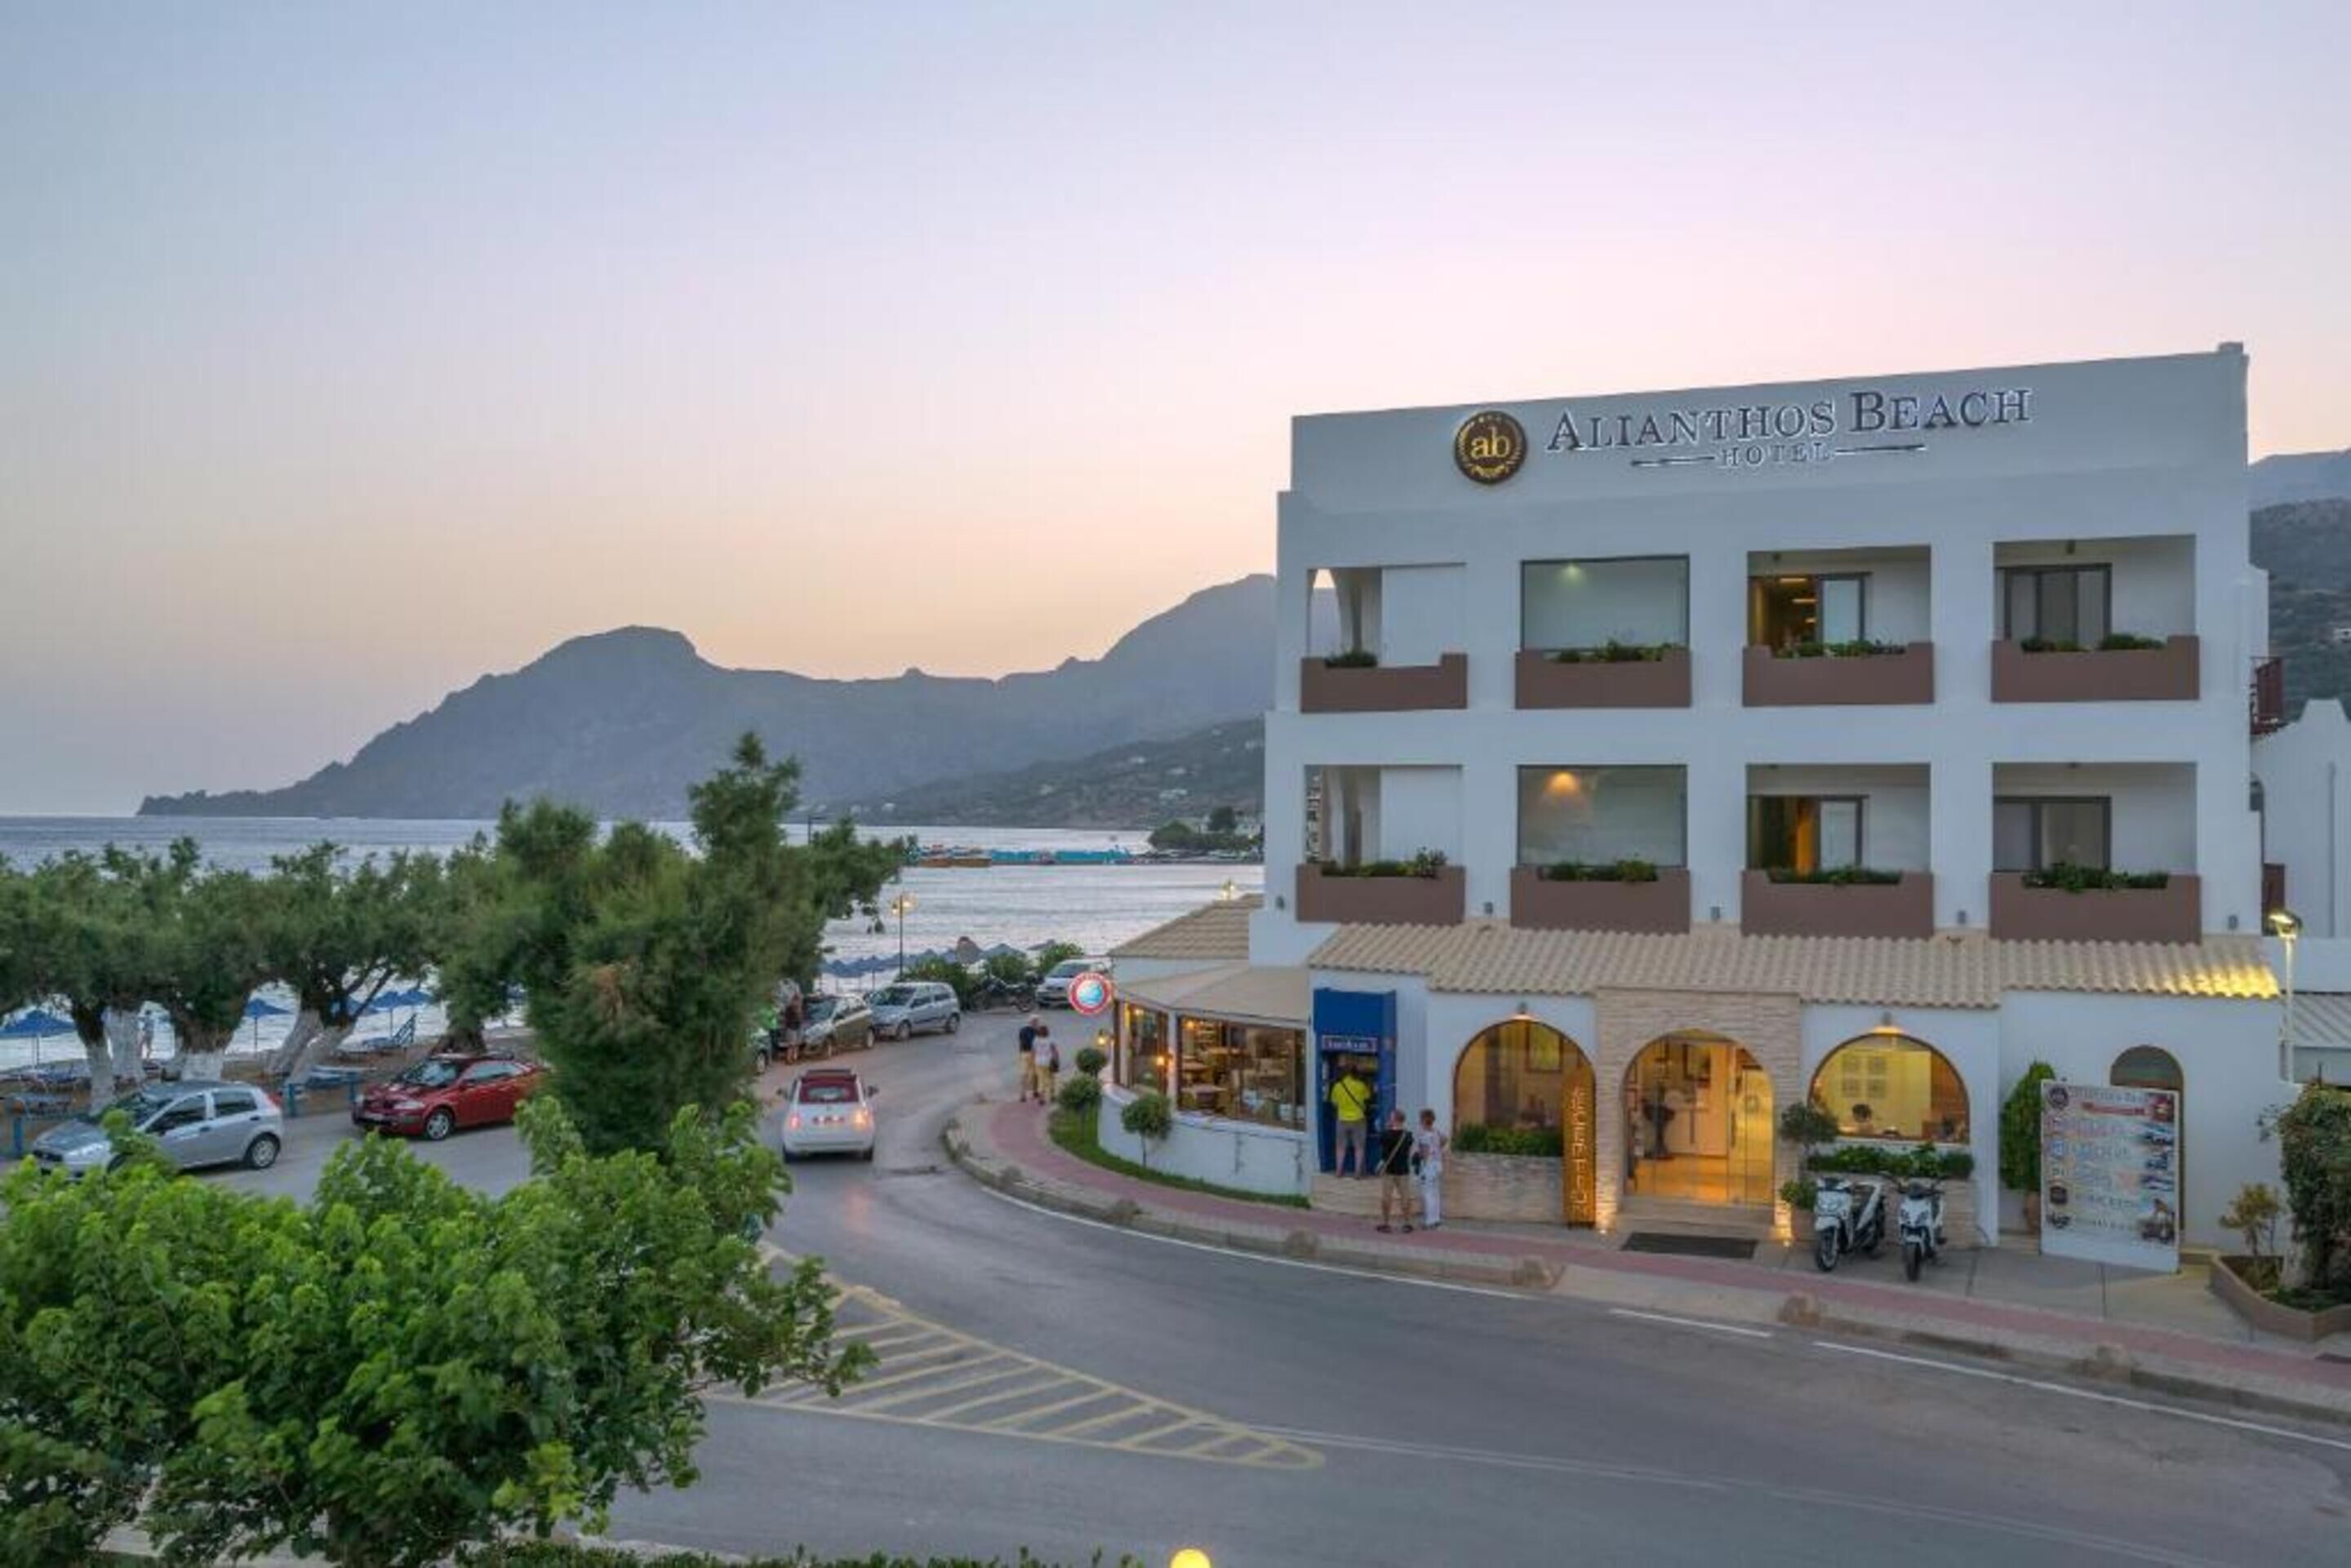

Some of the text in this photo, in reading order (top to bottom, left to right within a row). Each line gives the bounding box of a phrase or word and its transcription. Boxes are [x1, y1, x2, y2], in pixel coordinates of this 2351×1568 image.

[1548, 389, 2030, 451] ALIANTHOS BEACH
[1470, 426, 1510, 459] ab
[1718, 442, 1832, 468] HOTEL
